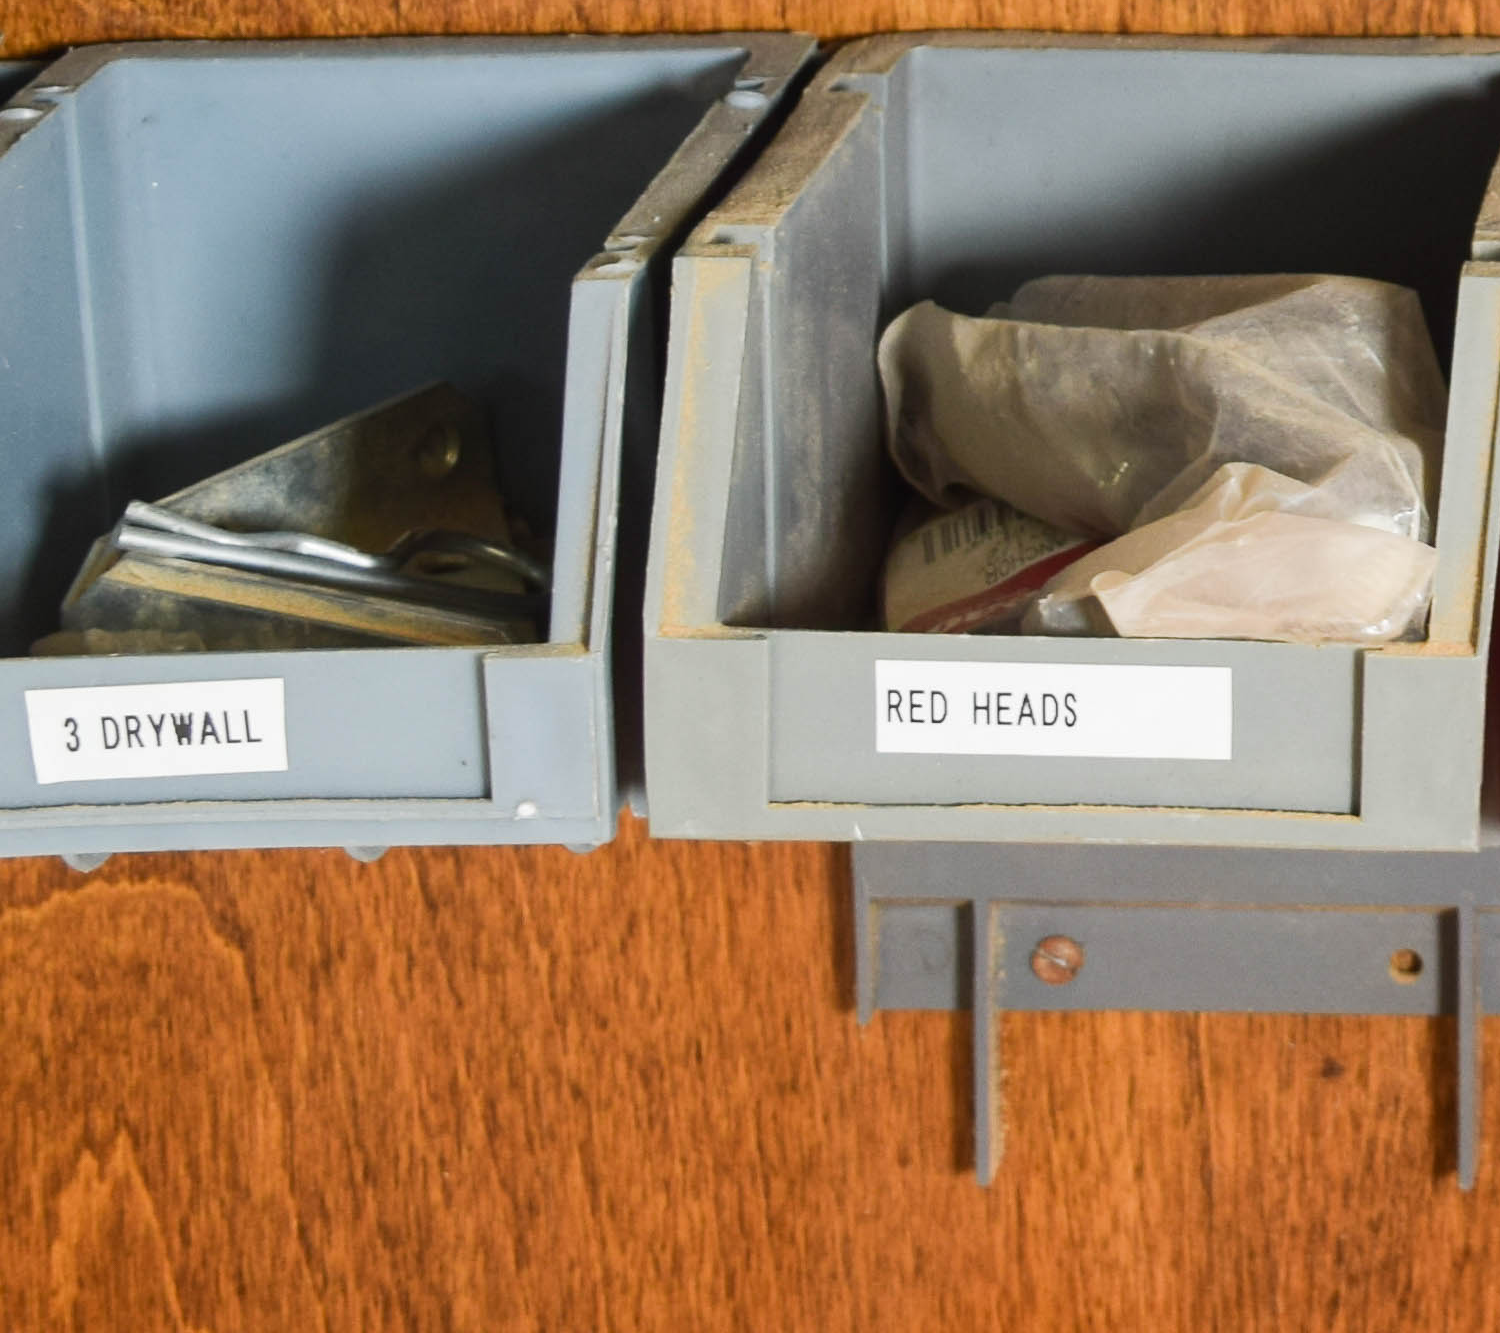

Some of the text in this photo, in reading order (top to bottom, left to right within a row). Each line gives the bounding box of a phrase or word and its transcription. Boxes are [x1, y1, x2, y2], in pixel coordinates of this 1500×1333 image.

[887, 689, 1078, 728] RED HEADS
[63, 709, 263, 753] 3 DRYWALL
